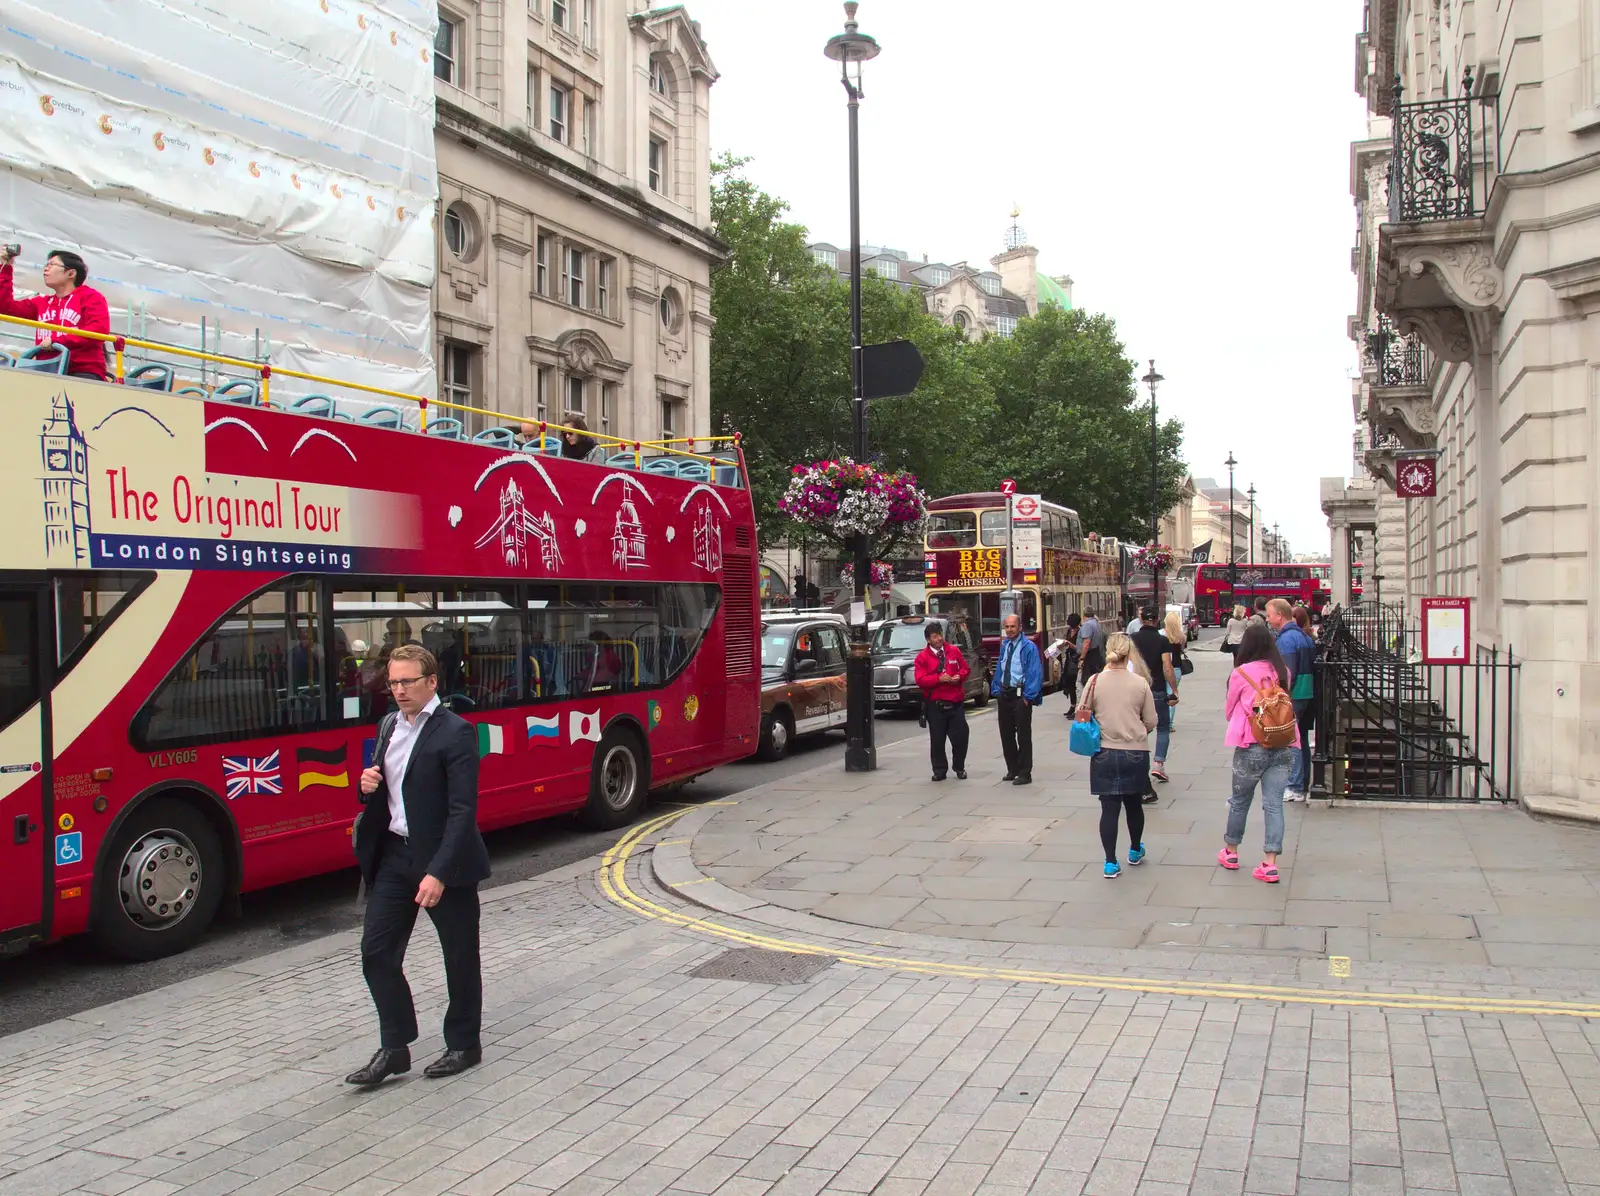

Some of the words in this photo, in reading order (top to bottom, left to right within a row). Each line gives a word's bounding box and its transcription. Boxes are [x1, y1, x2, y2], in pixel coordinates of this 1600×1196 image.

[52, 98, 85, 116] overbury
[110, 118, 142, 135] overbury
[162, 135, 191, 152] overbury
[1003, 481, 1013, 494] Z
[106, 466, 158, 522] The
[173, 475, 282, 539] Original
[291, 486, 341, 533] Tour
[100, 539, 201, 561] London
[216, 544, 351, 569] Sightseeing
[960, 549, 1001, 561] BIG
[959, 560, 1001, 571] BUS
[960, 570, 1001, 579] TOURS
[805, 705, 828, 716] Revealing
[829, 701, 842, 711] China
[149, 750, 197, 768] VLY605
[54, 779, 92, 789] EMERGENCY
[54, 787, 74, 796] PRESS
[76, 783, 101, 792] BUTTON
[80, 789, 101, 797] DOORS
